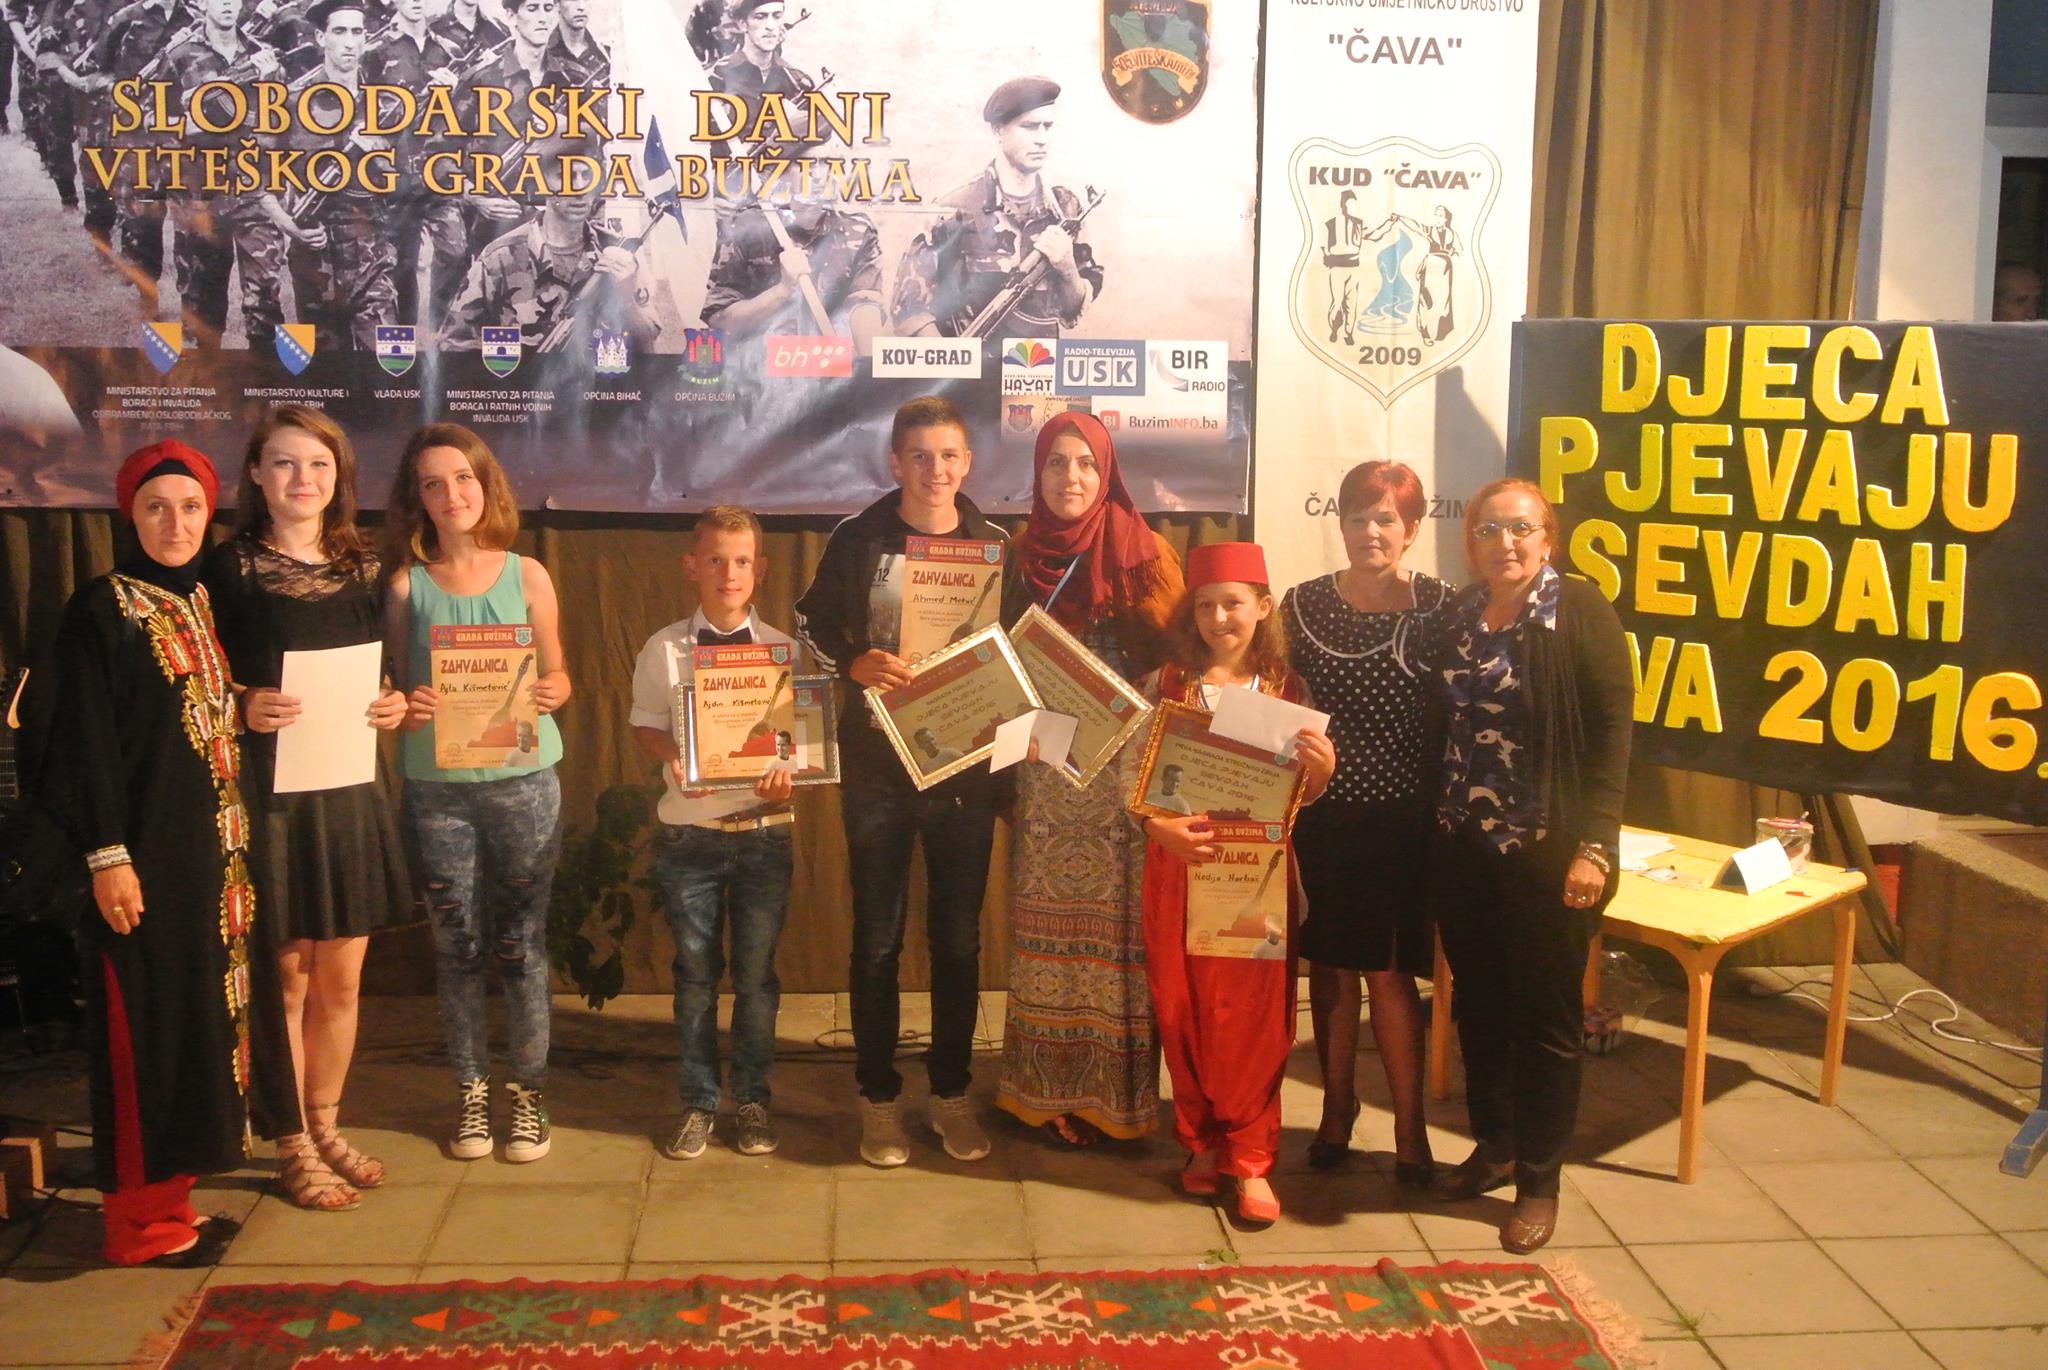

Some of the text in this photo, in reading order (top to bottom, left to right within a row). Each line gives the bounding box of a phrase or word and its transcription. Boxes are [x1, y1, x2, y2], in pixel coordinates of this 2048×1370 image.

[1329, 28, 1463, 66] "ČAVA"
[110, 75, 891, 146] SLOBODARSKI DANI
[82, 138, 922, 203] VITEŠKOG GRADA BUŽIMA
[1309, 162, 1482, 190] KUD "ČAVA"
[774, 345, 808, 368] bh
[882, 349, 973, 366] KOV-GRAD
[1064, 347, 1136, 357] RADIO-TELEVIZIJA
[1171, 350, 1209, 370] BIR
[1358, 345, 1423, 366] 2009
[1067, 359, 1134, 384] USK
[1601, 323, 1951, 426] DJECA
[106, 386, 217, 397] MINISTARSTVO ZA PITANJA
[243, 388, 305, 398] MINISTARSTVO
[307, 389, 343, 399] KULTURE
[374, 389, 421, 399] VLADA USK
[1004, 379, 1053, 393] HAYAT
[1192, 381, 1226, 393] RADIO
[446, 390, 555, 401] MINISTARSTVO ZA PITANJA
[449, 402, 484, 411] BORACA
[490, 402, 521, 412] RATNIH
[522, 403, 552, 413] VOJNIH
[472, 413, 529, 423] INVALIDA USK
[1128, 414, 1219, 431] BuzimINFO.ba
[1538, 416, 2020, 533] PJEVAJU
[912, 570, 976, 588] ZAHVALNICA
[1565, 518, 1968, 644] SEVDAH
[456, 631, 513, 643] GRADA BUŽIMA
[440, 658, 508, 674] ZAHVALNICA
[703, 674, 767, 692] ZAHVALNICA
[1624, 631, 2048, 780] VA 2016.
[1213, 850, 1261, 866] VALNICA
